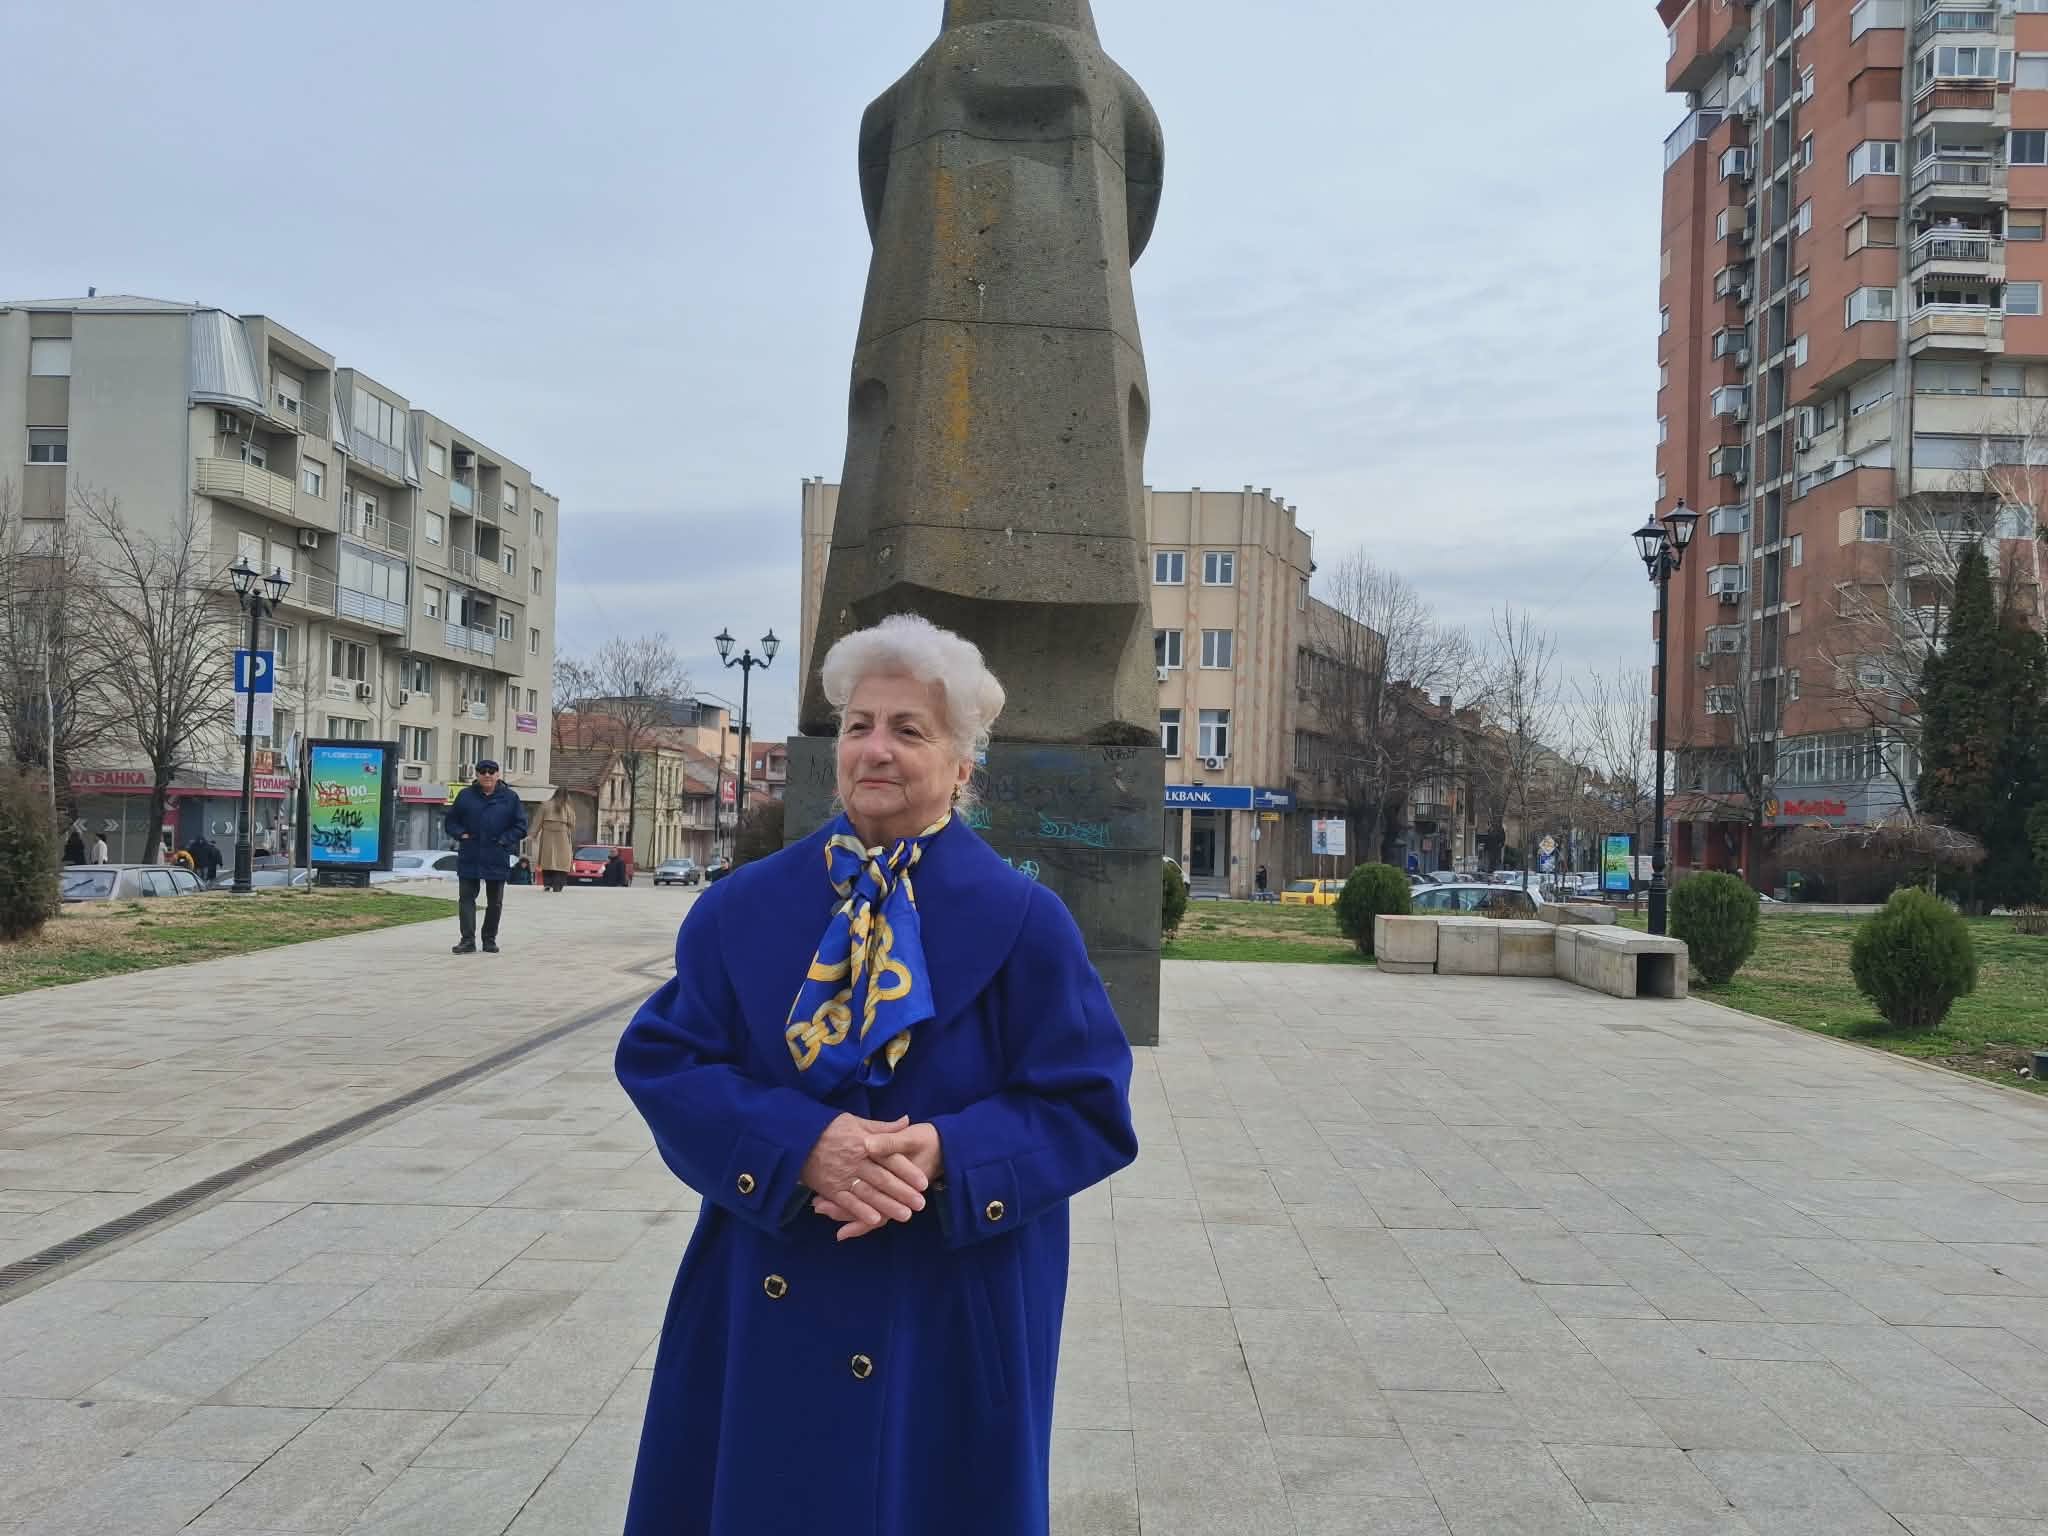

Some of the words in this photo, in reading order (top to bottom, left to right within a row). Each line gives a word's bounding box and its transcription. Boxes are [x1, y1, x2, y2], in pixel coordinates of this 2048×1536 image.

[243, 655, 267, 689] P
[94, 771, 146, 785] БАНКА
[1165, 791, 1212, 802] LKBANK
